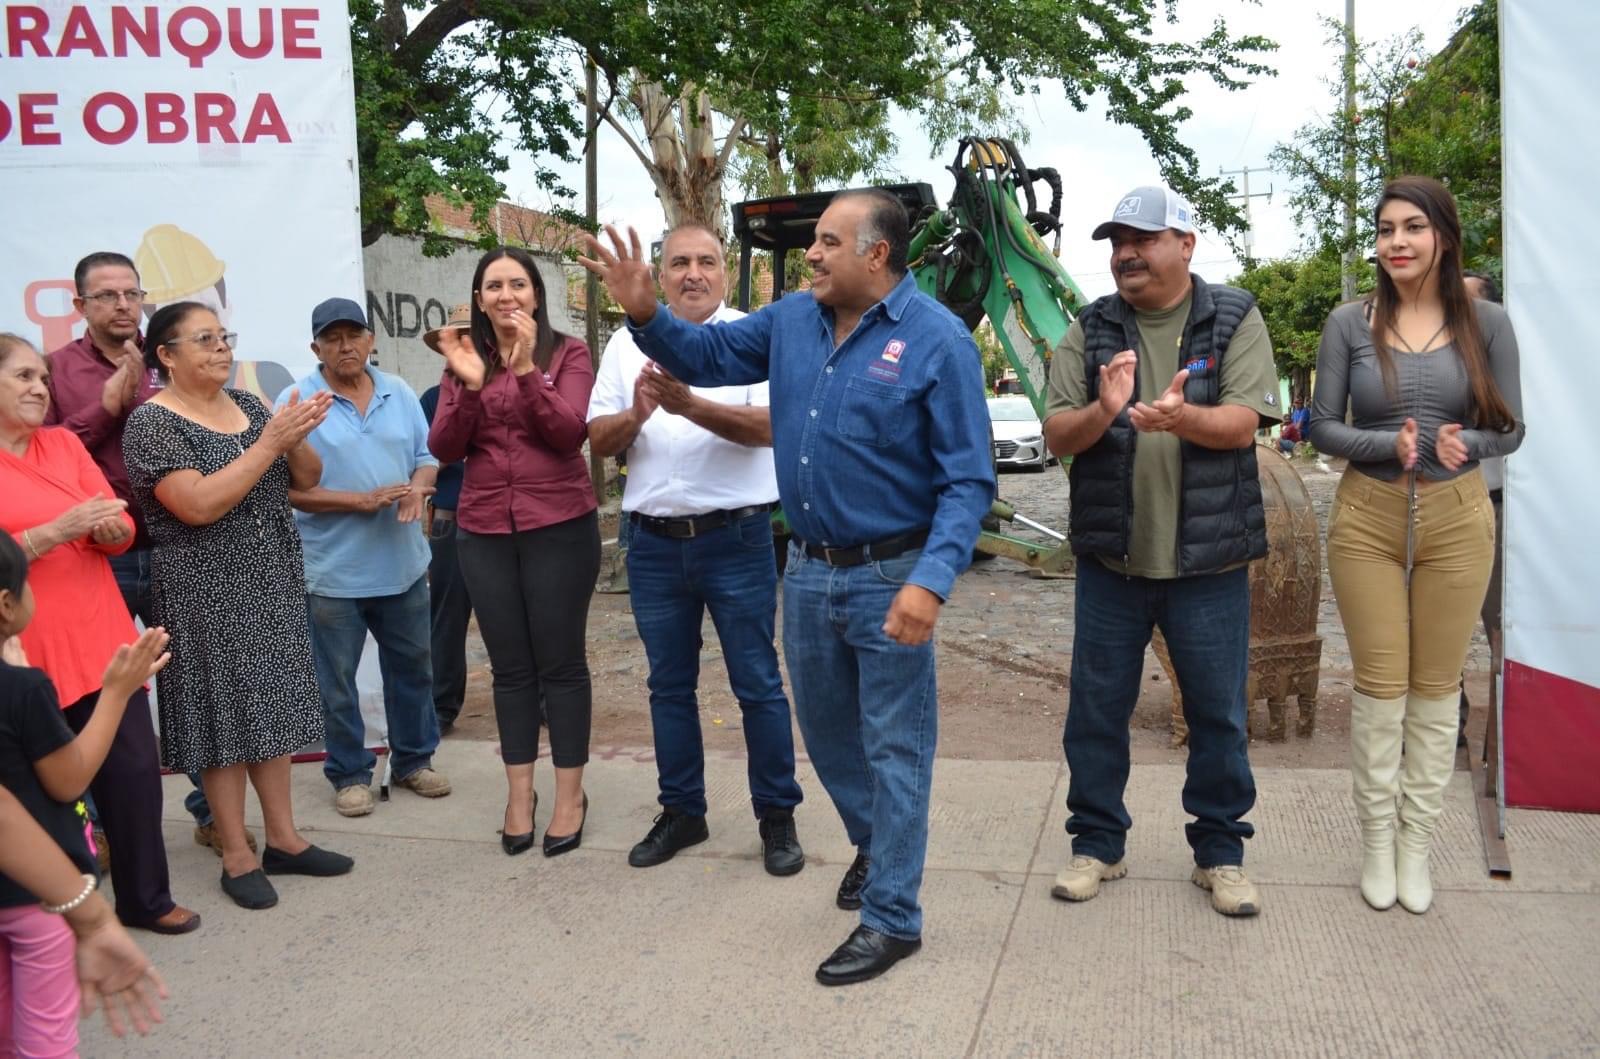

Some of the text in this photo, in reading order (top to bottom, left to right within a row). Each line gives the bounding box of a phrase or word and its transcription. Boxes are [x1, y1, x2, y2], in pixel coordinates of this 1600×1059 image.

[0, 5, 323, 69] RANQUE
[0, 91, 293, 146] E OBRA
